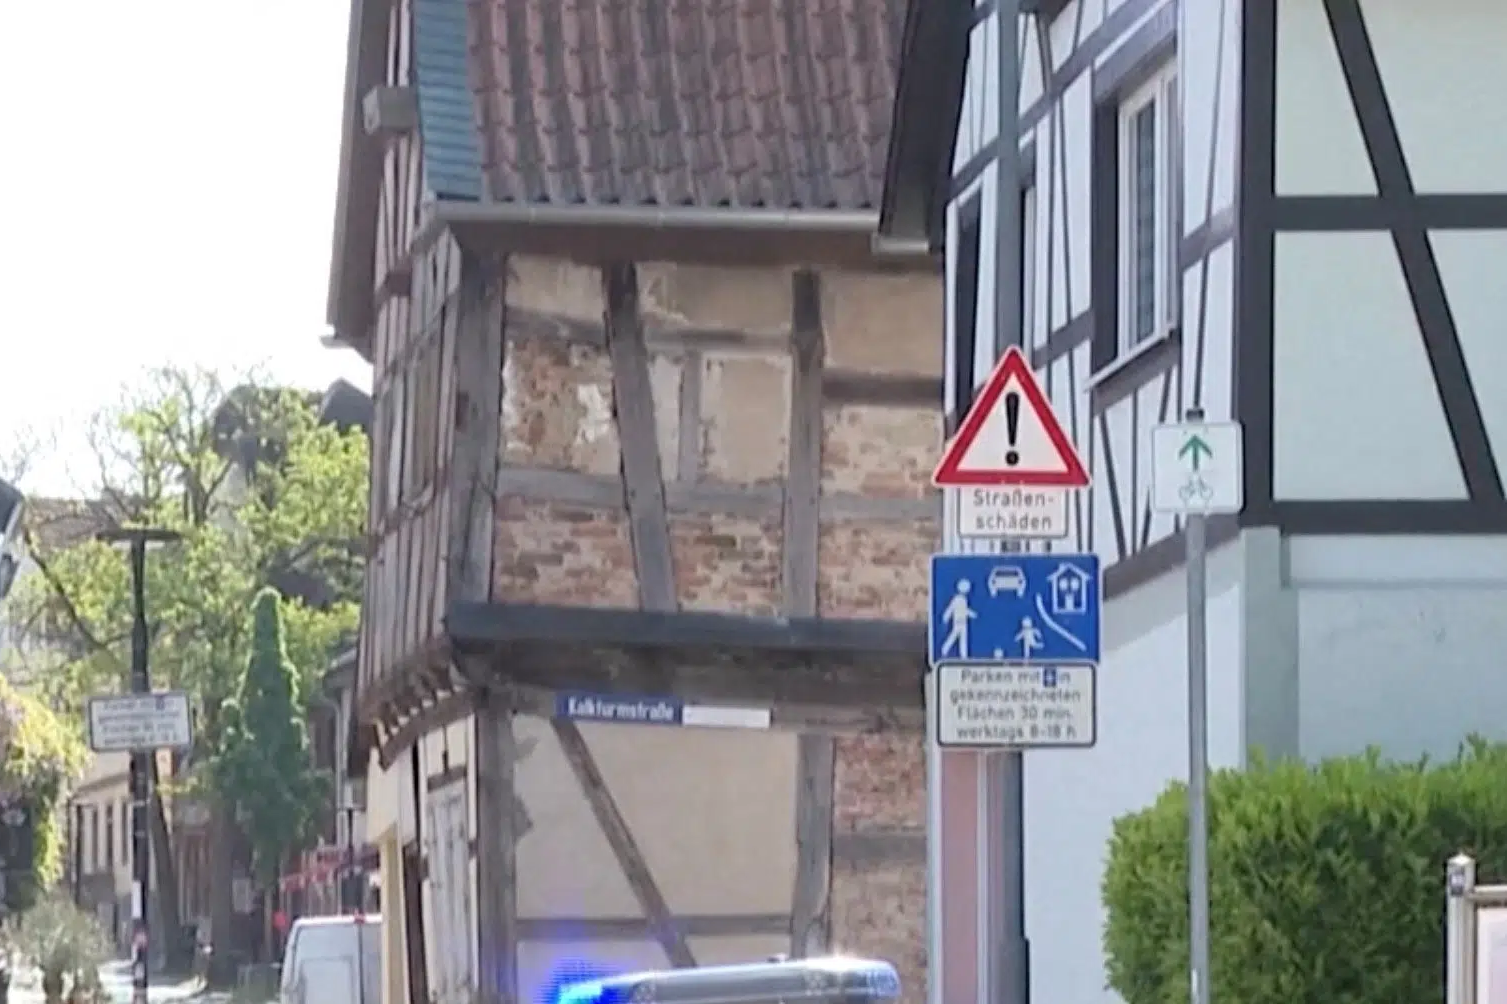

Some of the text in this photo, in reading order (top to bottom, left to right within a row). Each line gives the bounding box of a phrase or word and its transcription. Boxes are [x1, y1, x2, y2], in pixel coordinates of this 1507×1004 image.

[973, 488, 1055, 507] Straßen-
[975, 510, 1052, 530] schäden
[961, 668, 1013, 683] Parken
[1018, 670, 1040, 683] mit
[957, 705, 1014, 720] Flächen
